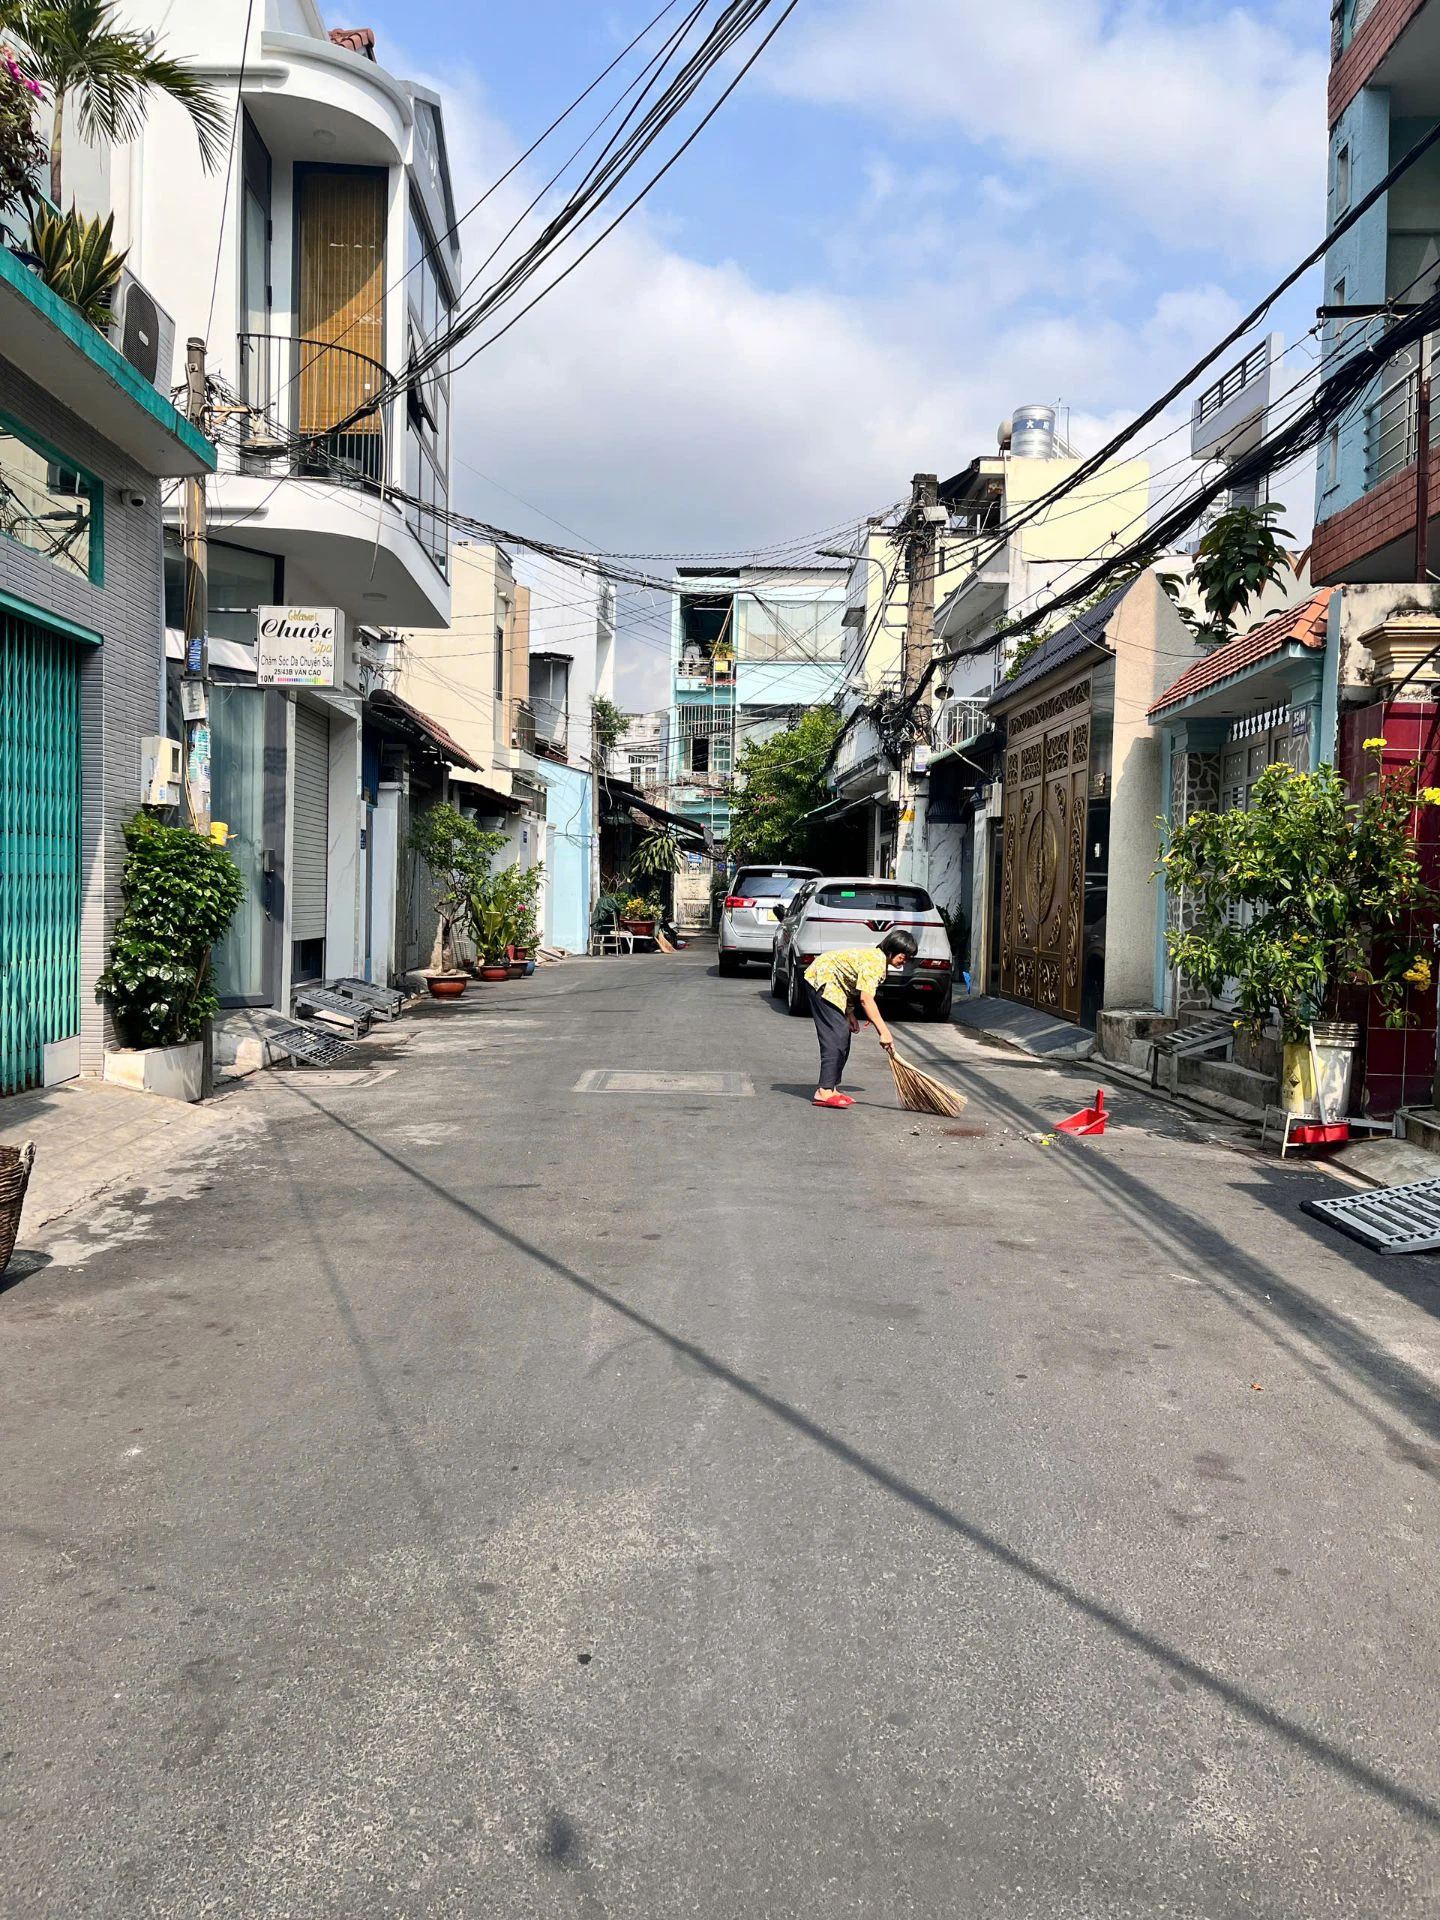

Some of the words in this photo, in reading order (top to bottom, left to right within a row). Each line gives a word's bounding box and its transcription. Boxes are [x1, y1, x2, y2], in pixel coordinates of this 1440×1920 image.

[261, 618, 333, 643] Chuộc
[312, 640, 333, 656] Spa
[290, 656, 299, 666] Da
[308, 669, 322, 677] CAO
[260, 674, 274, 683] 10M
